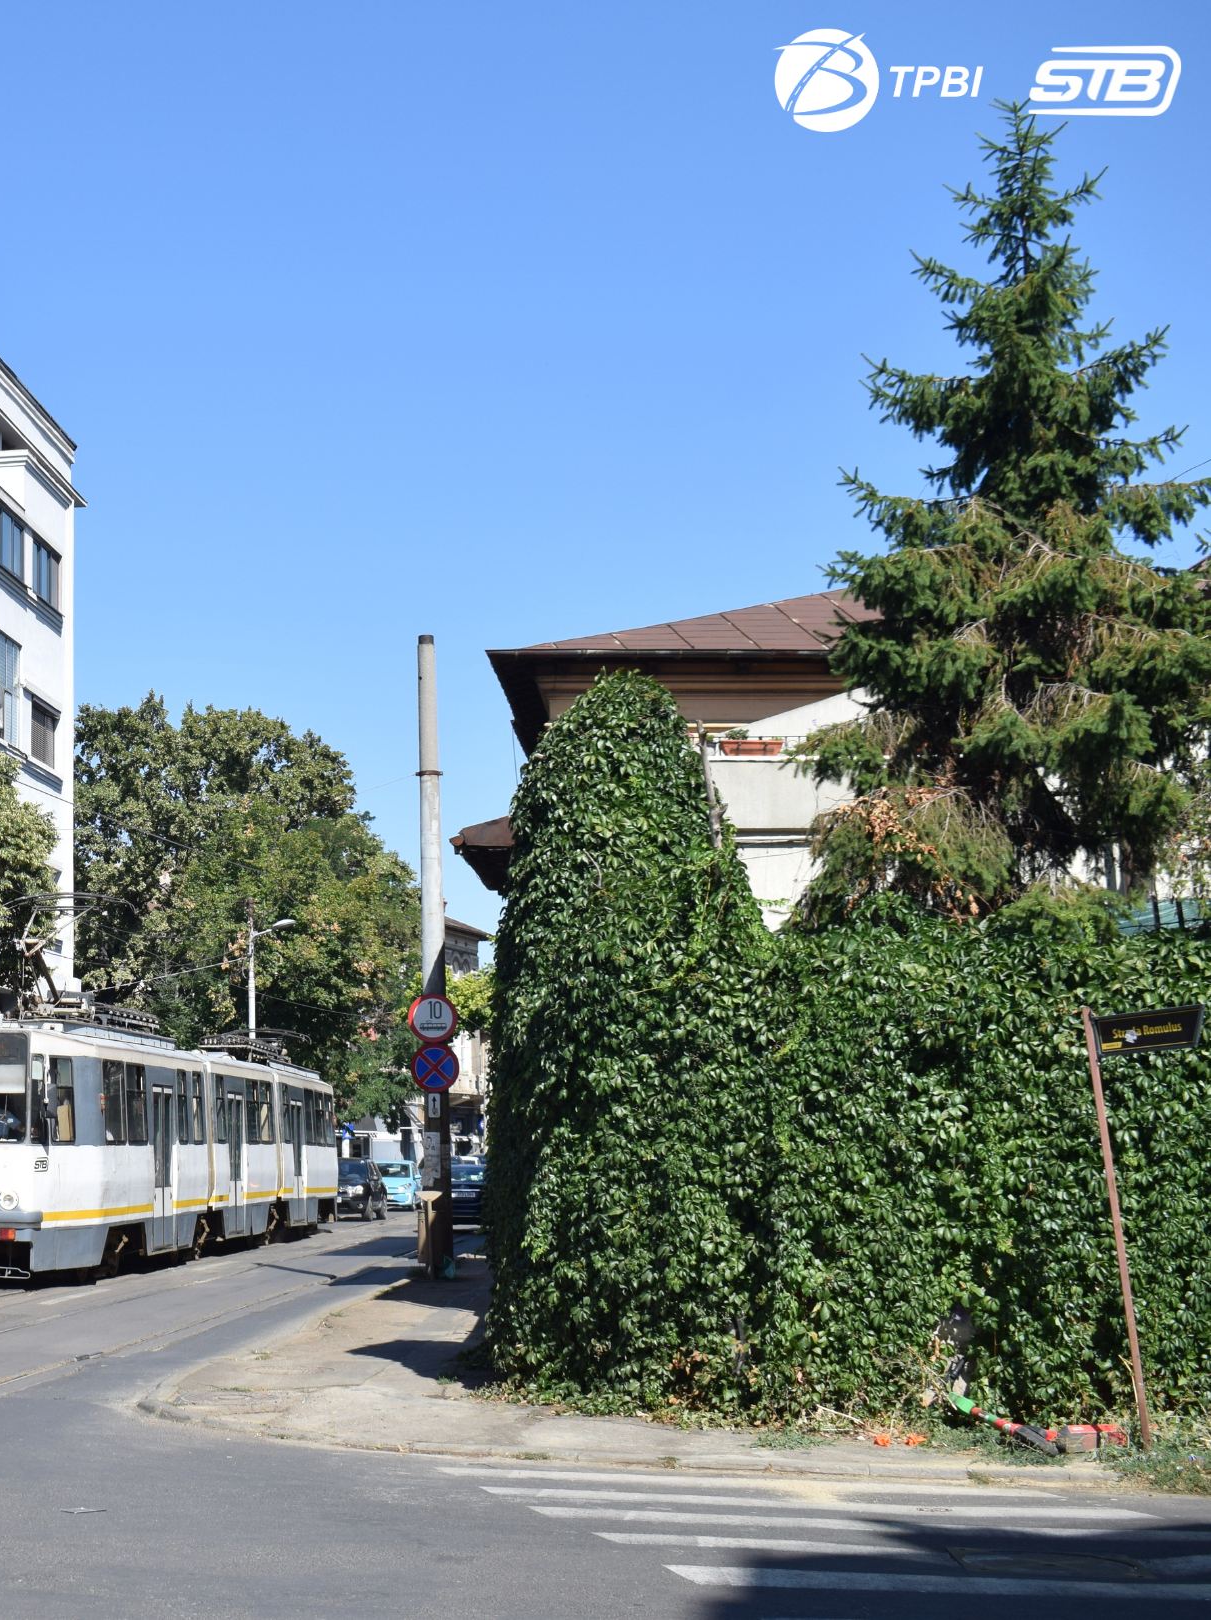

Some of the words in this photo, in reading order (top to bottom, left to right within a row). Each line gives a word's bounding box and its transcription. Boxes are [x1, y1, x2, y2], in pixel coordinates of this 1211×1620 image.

[427, 1000, 442, 1019] 10
[1112, 1026, 1142, 1039] Stra
[1142, 1022, 1182, 1035] Romulus
[34, 1158, 48, 1171] STB
